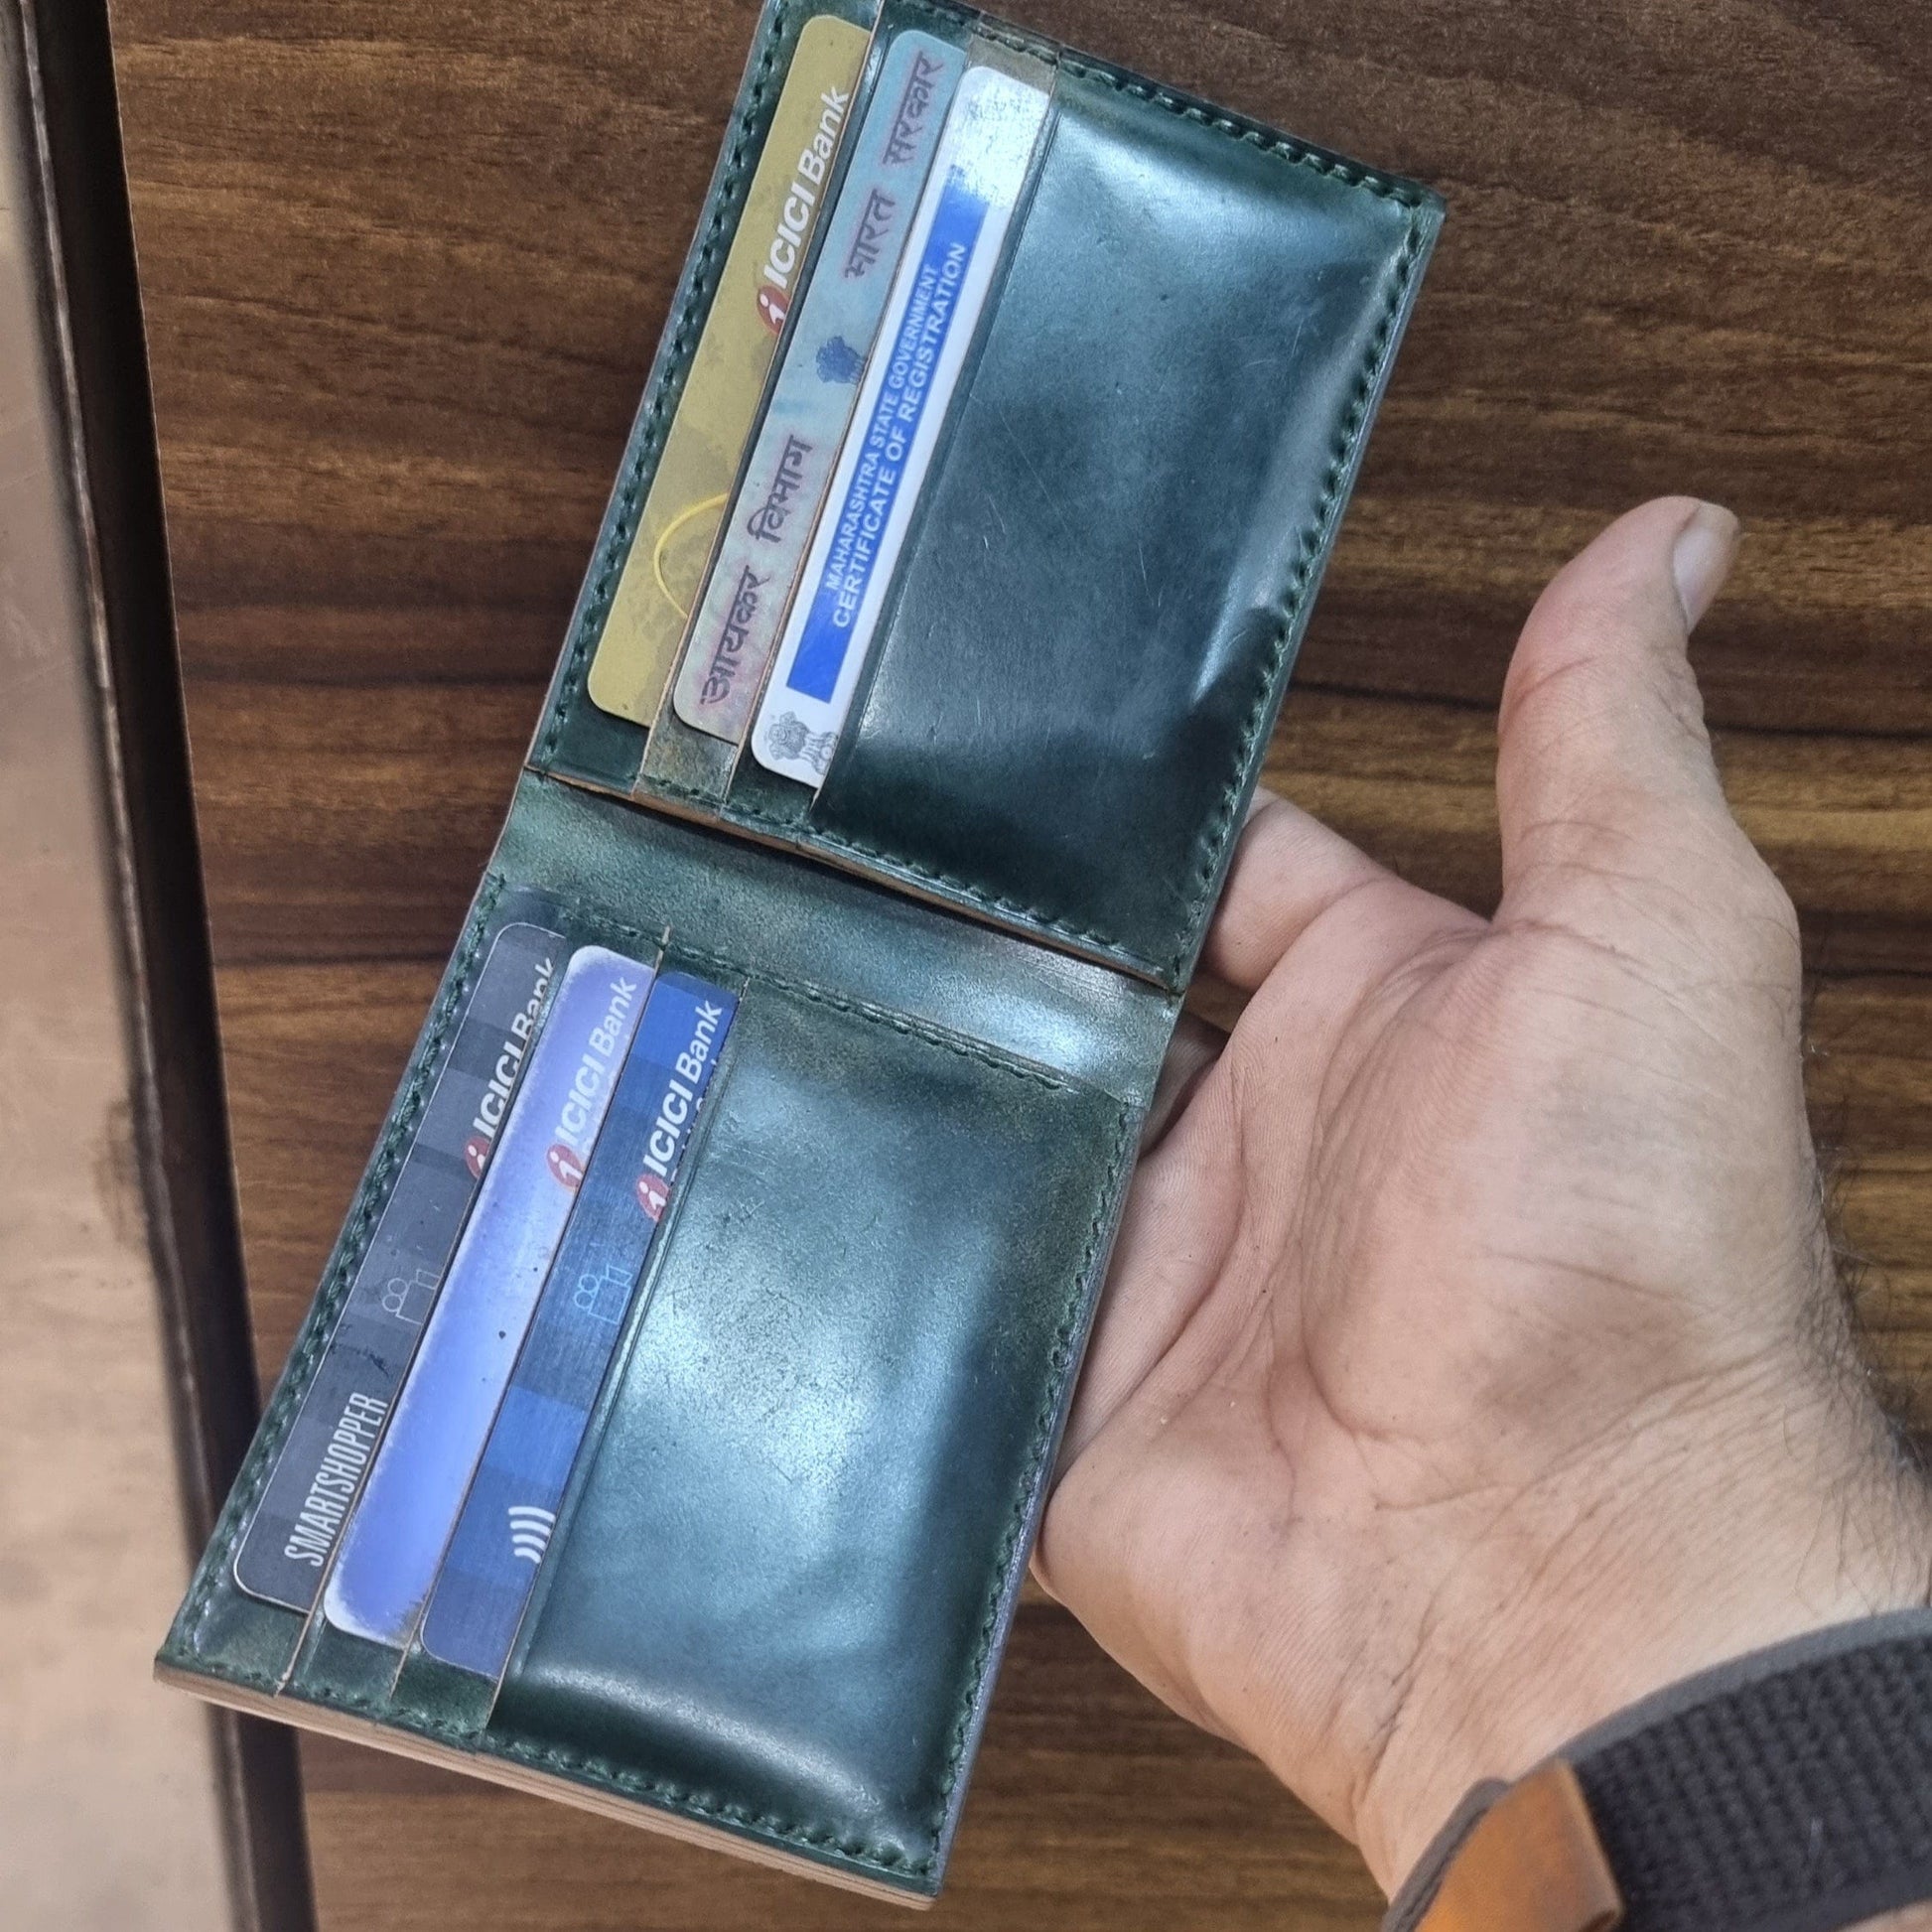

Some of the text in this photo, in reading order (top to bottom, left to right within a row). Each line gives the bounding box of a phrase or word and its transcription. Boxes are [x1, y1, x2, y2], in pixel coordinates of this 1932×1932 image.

[763, 181, 817, 289] ICICI
[797, 85, 850, 186] Bank
[844, 50, 944, 279] भारत सरकार
[826, 263, 939, 591] MAHARASHTRA STATE GOVERNMENT
[832, 242, 966, 628] CERTIFICATE OF REGISTRATION
[700, 434, 813, 706] आयकर विभाग
[473, 1041, 525, 1139] ICICI
[511, 957, 555, 1041] Bank
[554, 1054, 606, 1146] ICICI
[589, 976, 637, 1057] Bank
[642, 1079, 693, 1177] ICICI
[675, 1000, 724, 1084] Bank
[284, 1392, 389, 1568] SMARTSHOPPER
